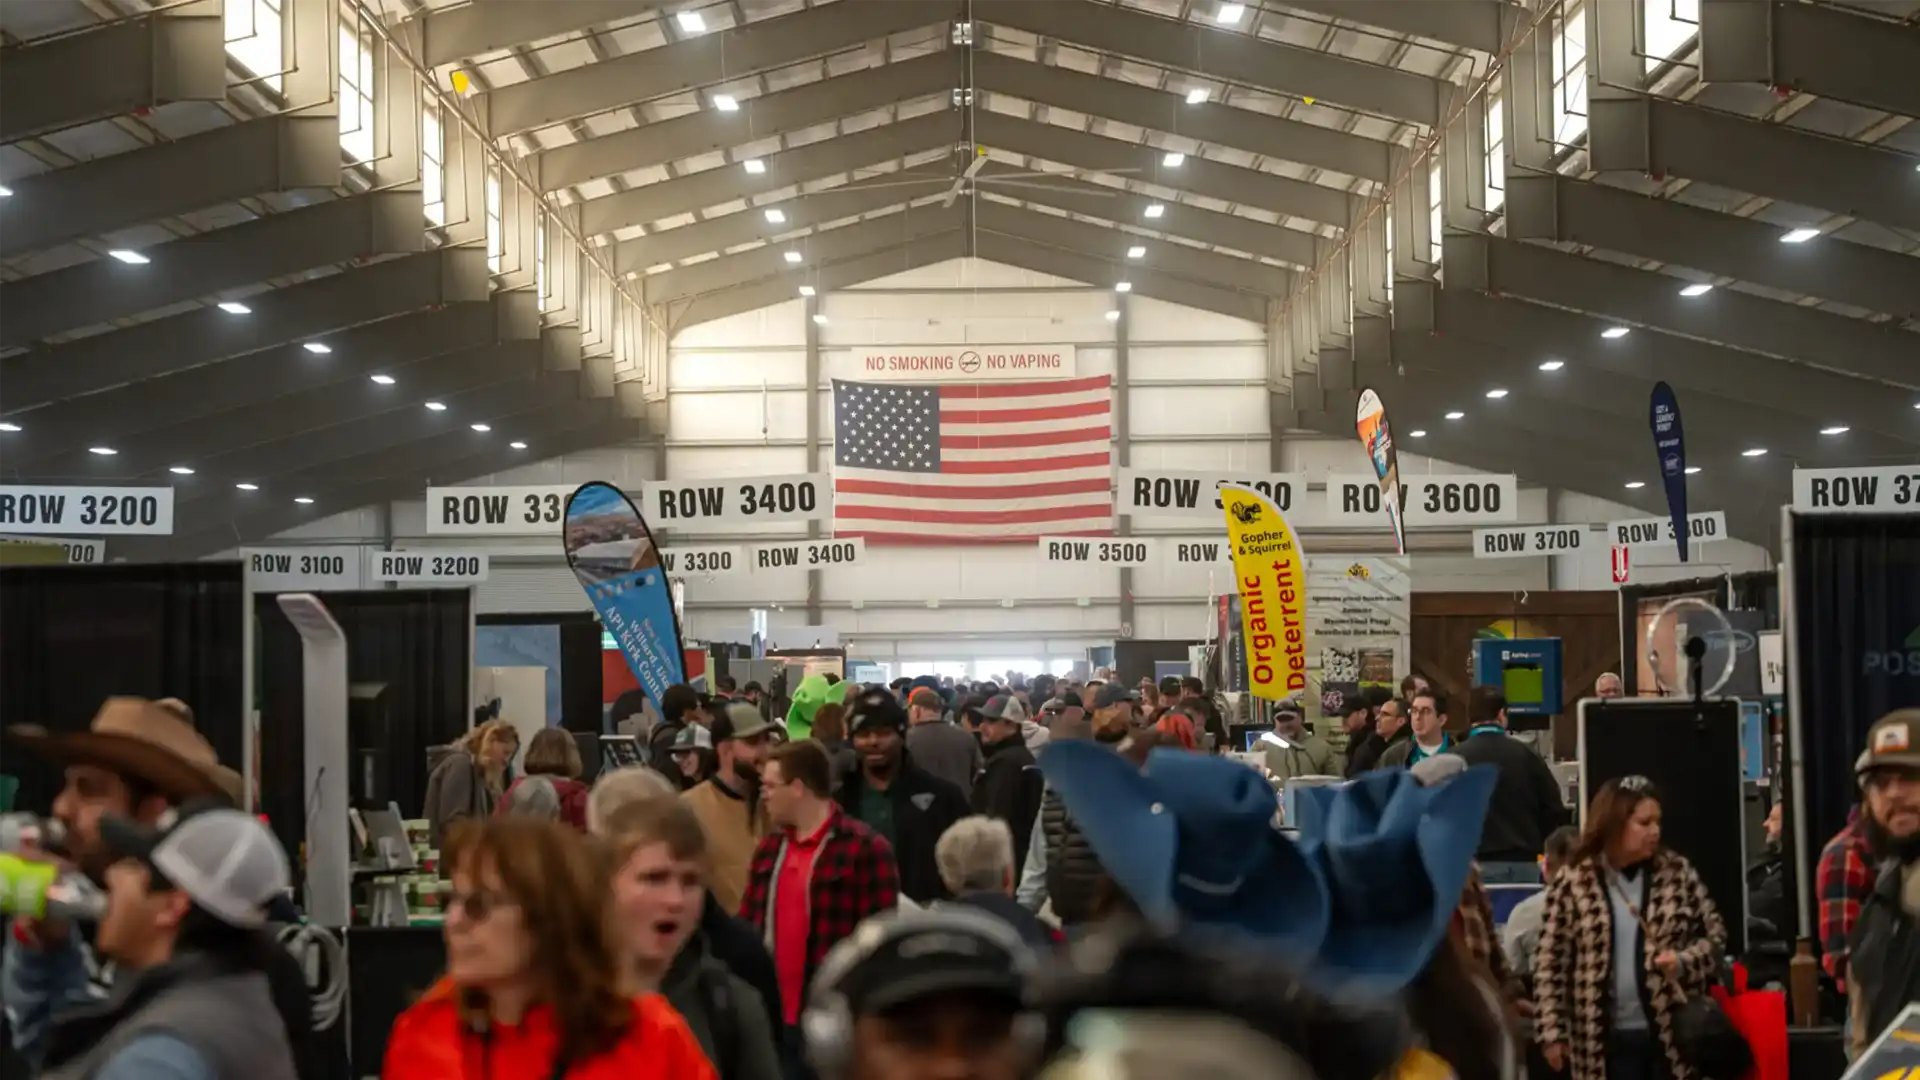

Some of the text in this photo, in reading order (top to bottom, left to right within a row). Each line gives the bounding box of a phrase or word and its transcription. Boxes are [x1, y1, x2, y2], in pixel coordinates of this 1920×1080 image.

[866, 354, 1061, 370] NO SMOKING NO VAPING
[659, 482, 816, 519] ROW 3400
[1134, 477, 1200, 508] ROW
[1343, 483, 1501, 513] RO 3600
[1811, 476, 1878, 507] ROW
[0, 494, 157, 526] ROW 3200
[443, 495, 509, 524] ROW
[1241, 531, 1284, 544] Gopher
[1484, 530, 1580, 552] ROW 3700
[1617, 517, 1716, 543] ROW 300
[684, 551, 732, 571] 3300
[758, 543, 855, 568] ROW 3400
[1049, 542, 1147, 562] ROW 3500
[1178, 544, 1218, 562] ROW
[1238, 546, 1246, 555] &
[1249, 541, 1292, 556] Squirrel
[252, 554, 344, 575] ROW 3100
[382, 557, 479, 576] ROW 3200
[1241, 575, 1276, 684] Organic
[1272, 559, 1305, 690] Deterrent
[639, 661, 664, 703] Conta
